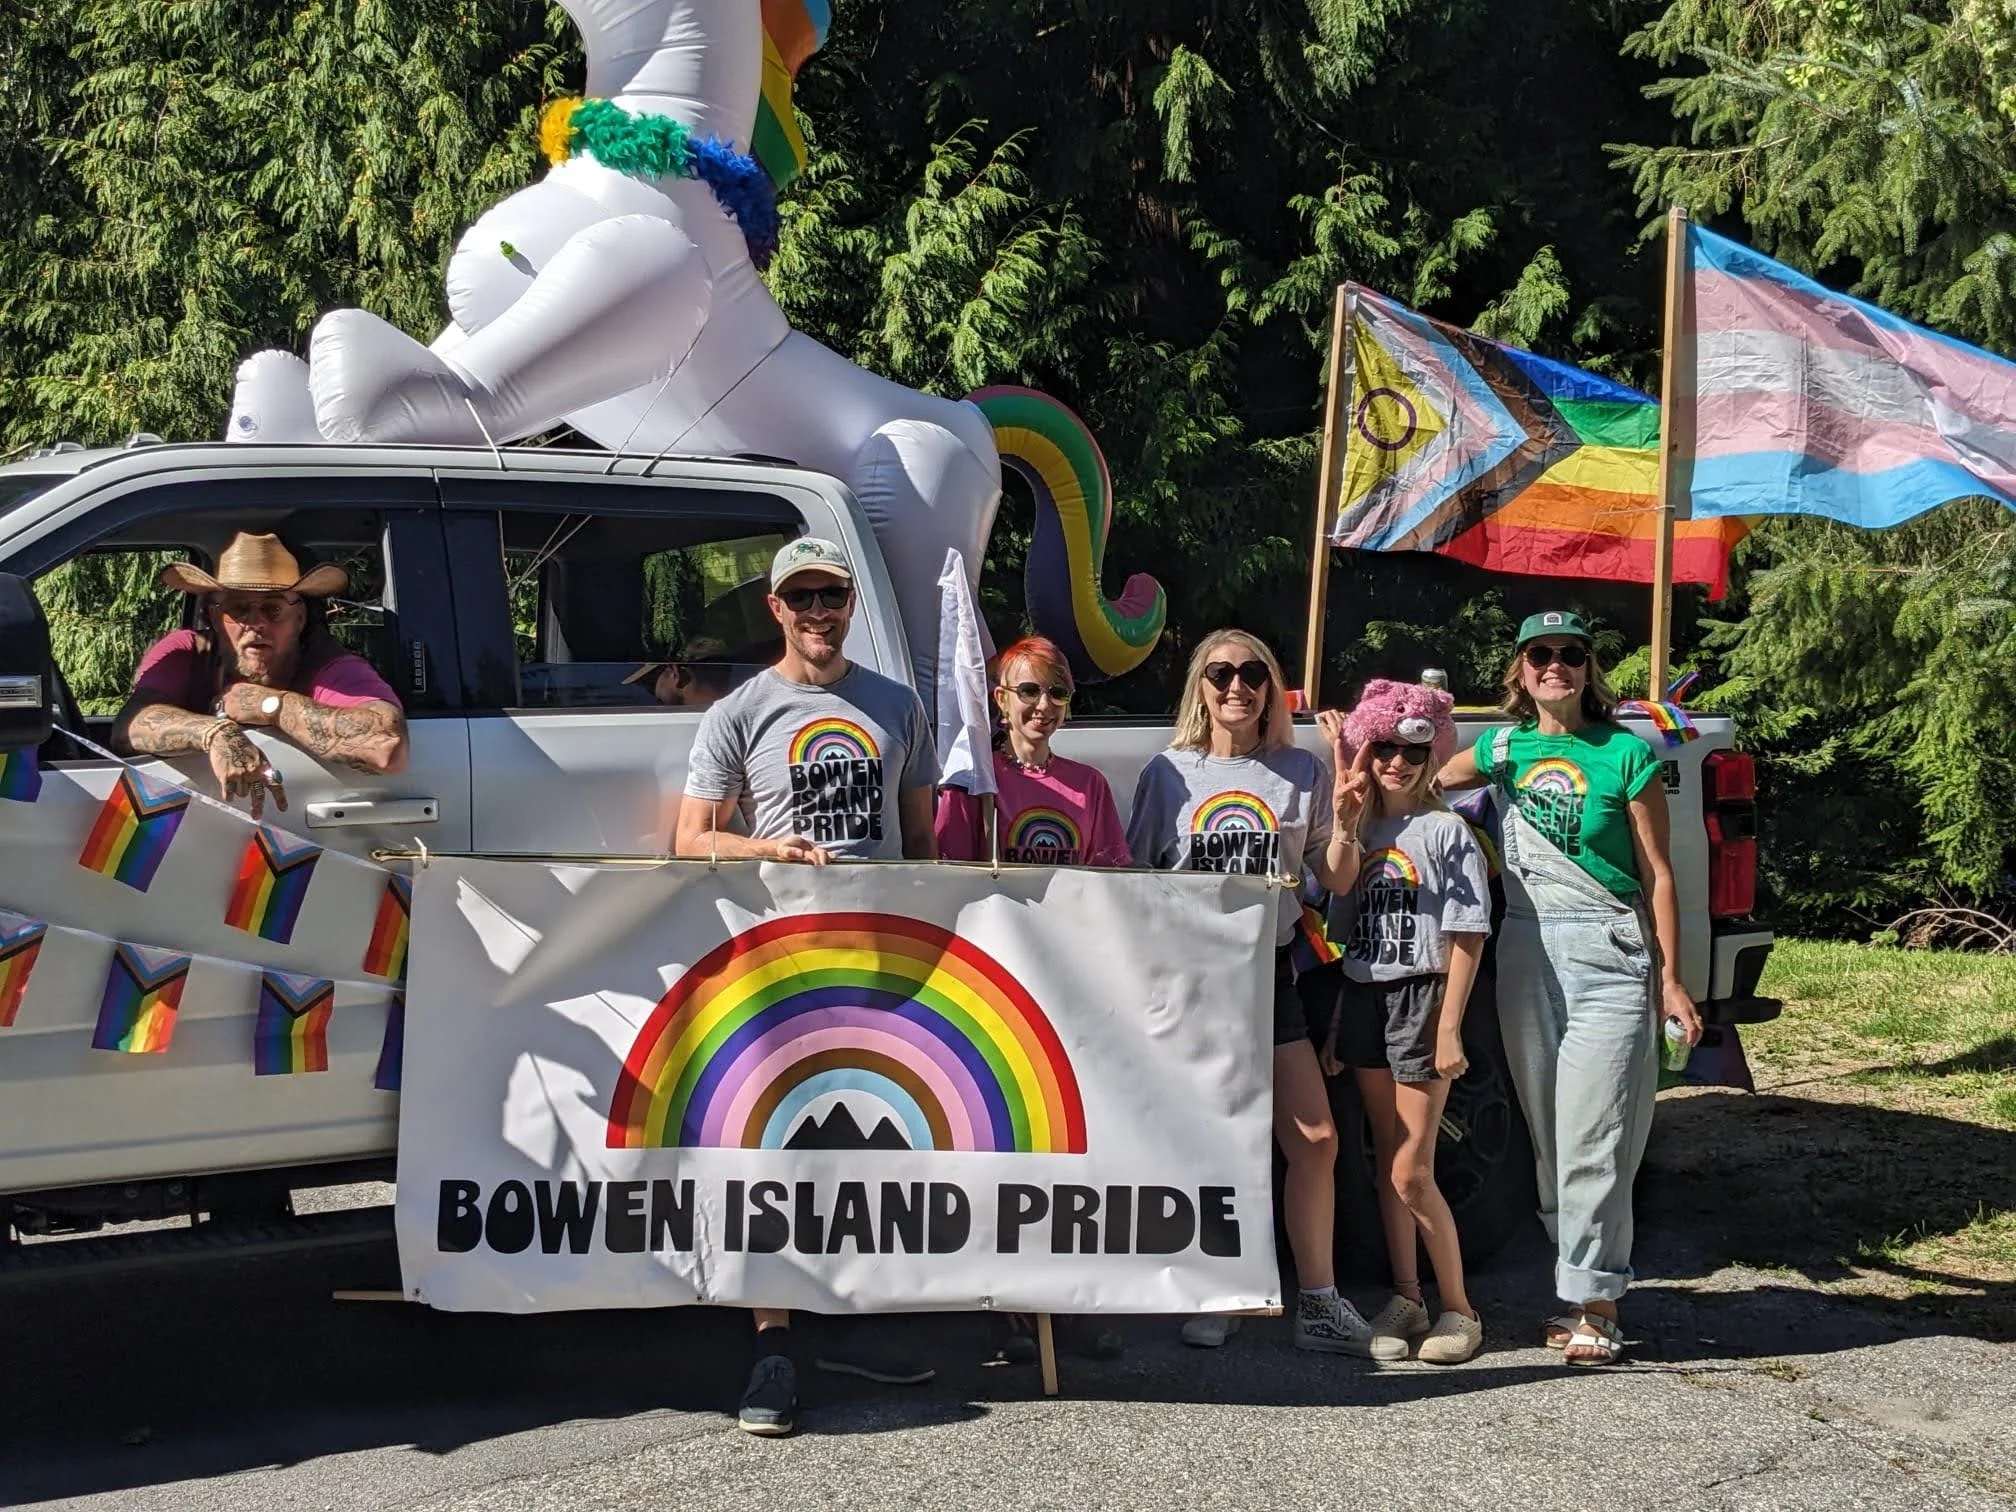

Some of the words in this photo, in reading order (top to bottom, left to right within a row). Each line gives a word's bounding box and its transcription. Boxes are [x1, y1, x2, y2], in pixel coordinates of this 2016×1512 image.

[789, 758, 883, 793] BOWEN
[793, 786, 882, 815] ISLAND
[793, 813, 883, 842] PRIDE
[1190, 830, 1279, 859] BOWEN
[1357, 888, 1418, 915] OWEN
[1352, 914, 1416, 941] LAND
[437, 1179, 695, 1254] BOWEN
[724, 1180, 971, 1254] ISLAND
[997, 1183, 1241, 1257] PRIDE
